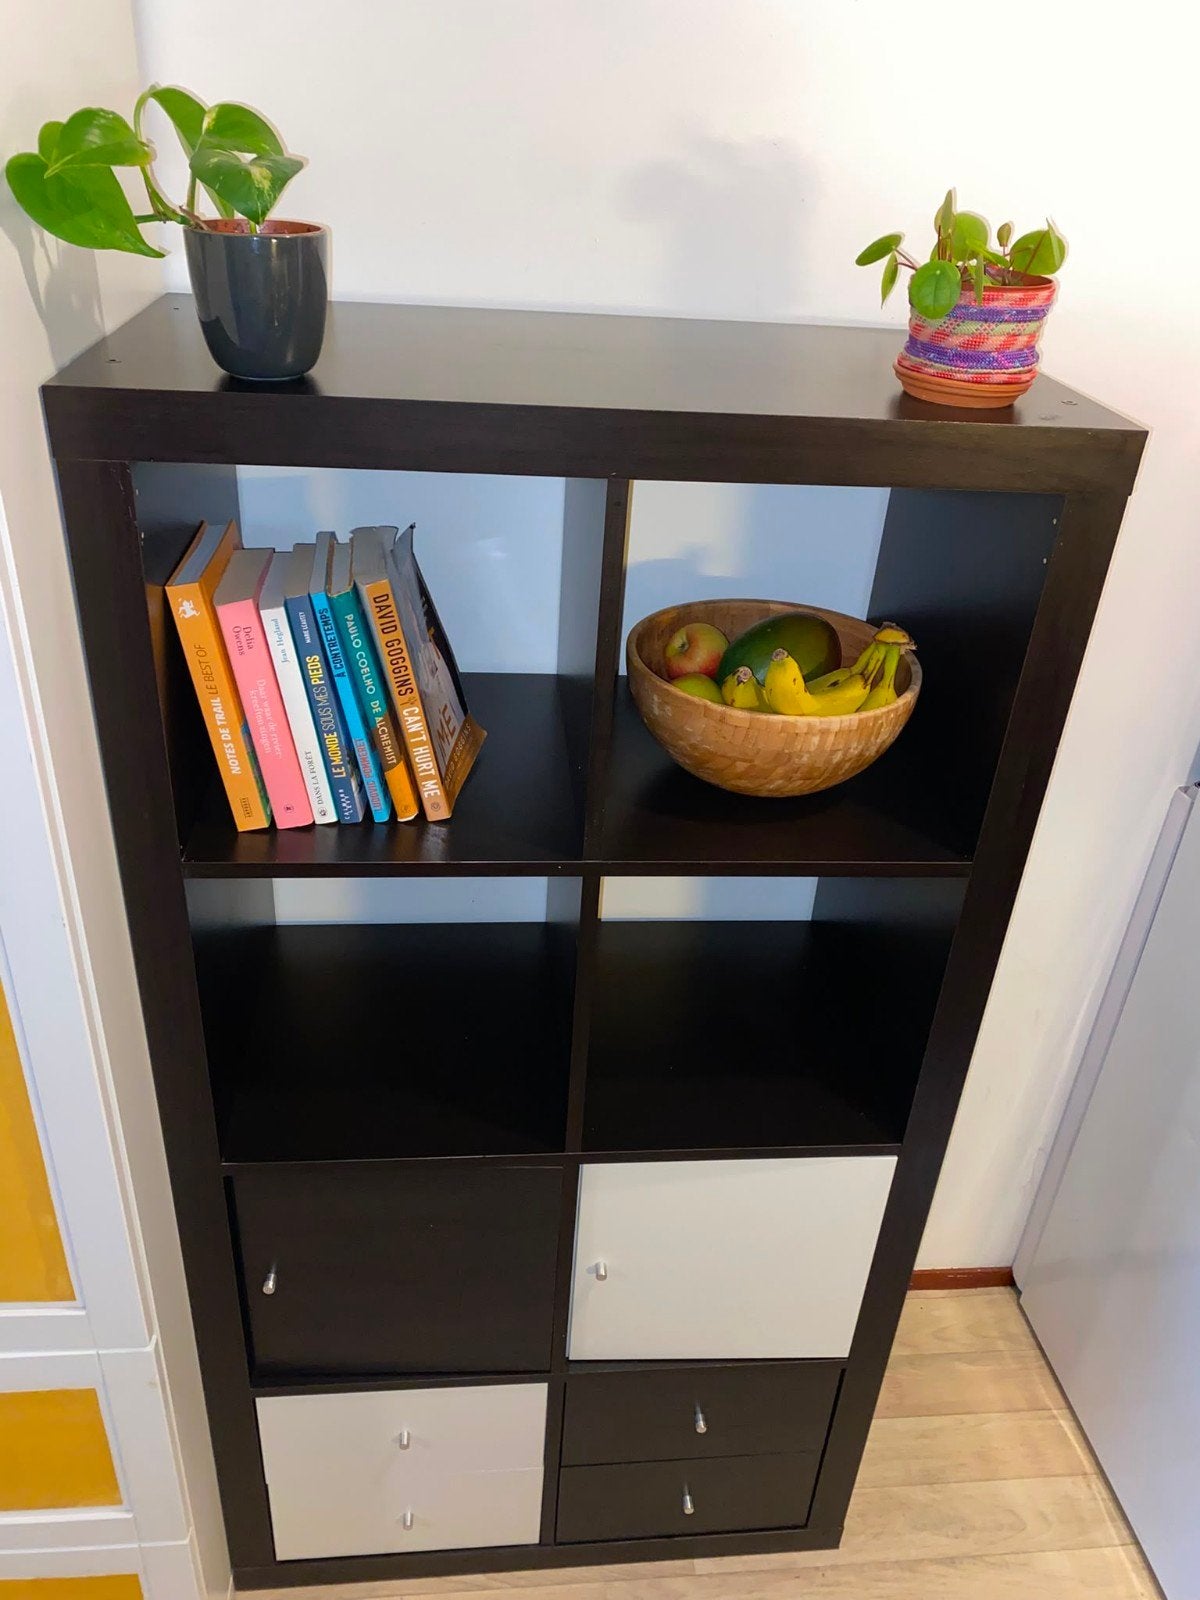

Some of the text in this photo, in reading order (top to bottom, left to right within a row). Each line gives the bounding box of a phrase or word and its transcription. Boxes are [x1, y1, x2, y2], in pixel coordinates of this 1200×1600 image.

[232, 625, 245, 656] Owens
[243, 626, 254, 650] Delia
[271, 618, 290, 663] Jean Hegland
[319, 607, 345, 670] CONTRETEMPS
[344, 613, 376, 694] PAULO COELHO
[373, 593, 414, 697] DAVID GOGGINS
[194, 644, 242, 775] NOTES DE TRAIL LE BEST OF
[306, 655, 346, 778] LE MONDE SOUS MES PIEDS
[370, 700, 397, 764] DE ALCHEMIST
[311, 774, 319, 784] LA
[402, 706, 441, 798] CAN'T HURT ME
[314, 785, 324, 805] DANS
